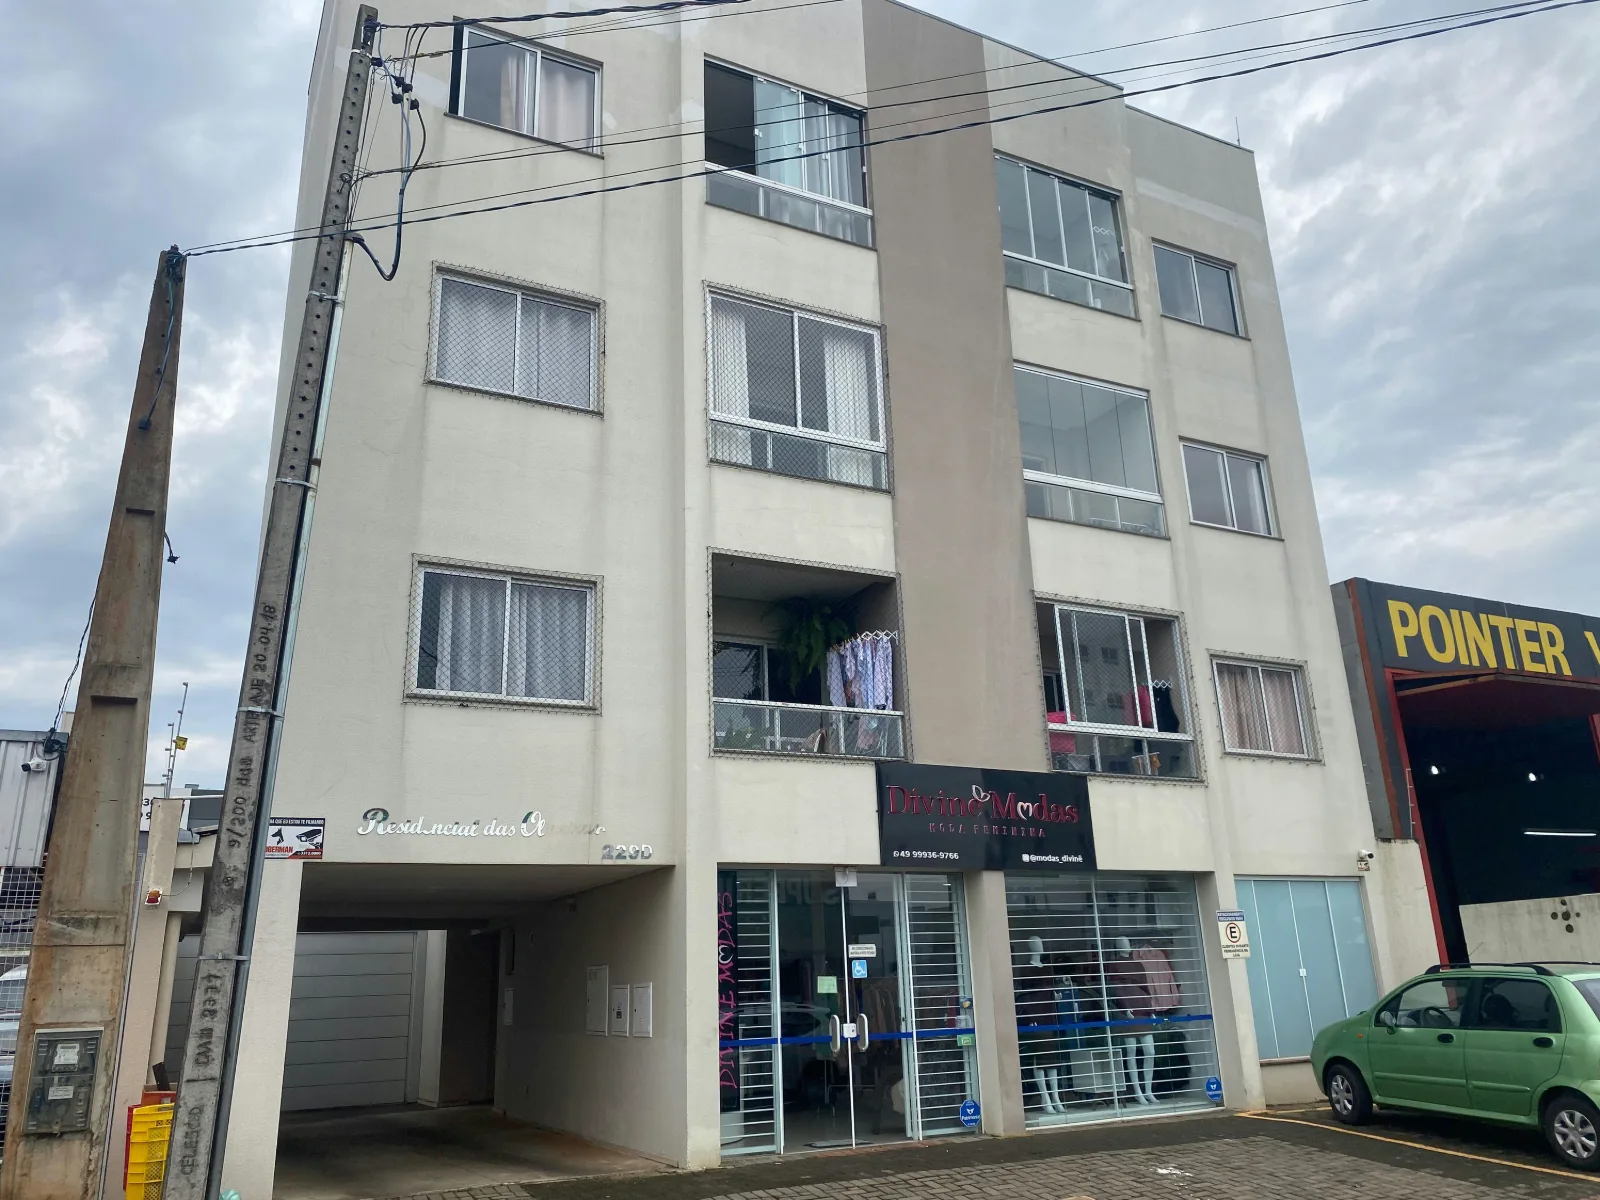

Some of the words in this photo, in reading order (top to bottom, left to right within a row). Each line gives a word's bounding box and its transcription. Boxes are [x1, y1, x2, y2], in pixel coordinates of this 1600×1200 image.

[1387, 599, 1572, 677] POINTER
[886, 785, 982, 817] Divine
[484, 818, 516, 837] das
[973, 824, 1046, 838] FEMININA
[900, 850, 911, 858] 49
[912, 850, 960, 860] 99936-9766
[1229, 926, 1237, 939] E
[718, 990, 738, 1090] DIVINE
